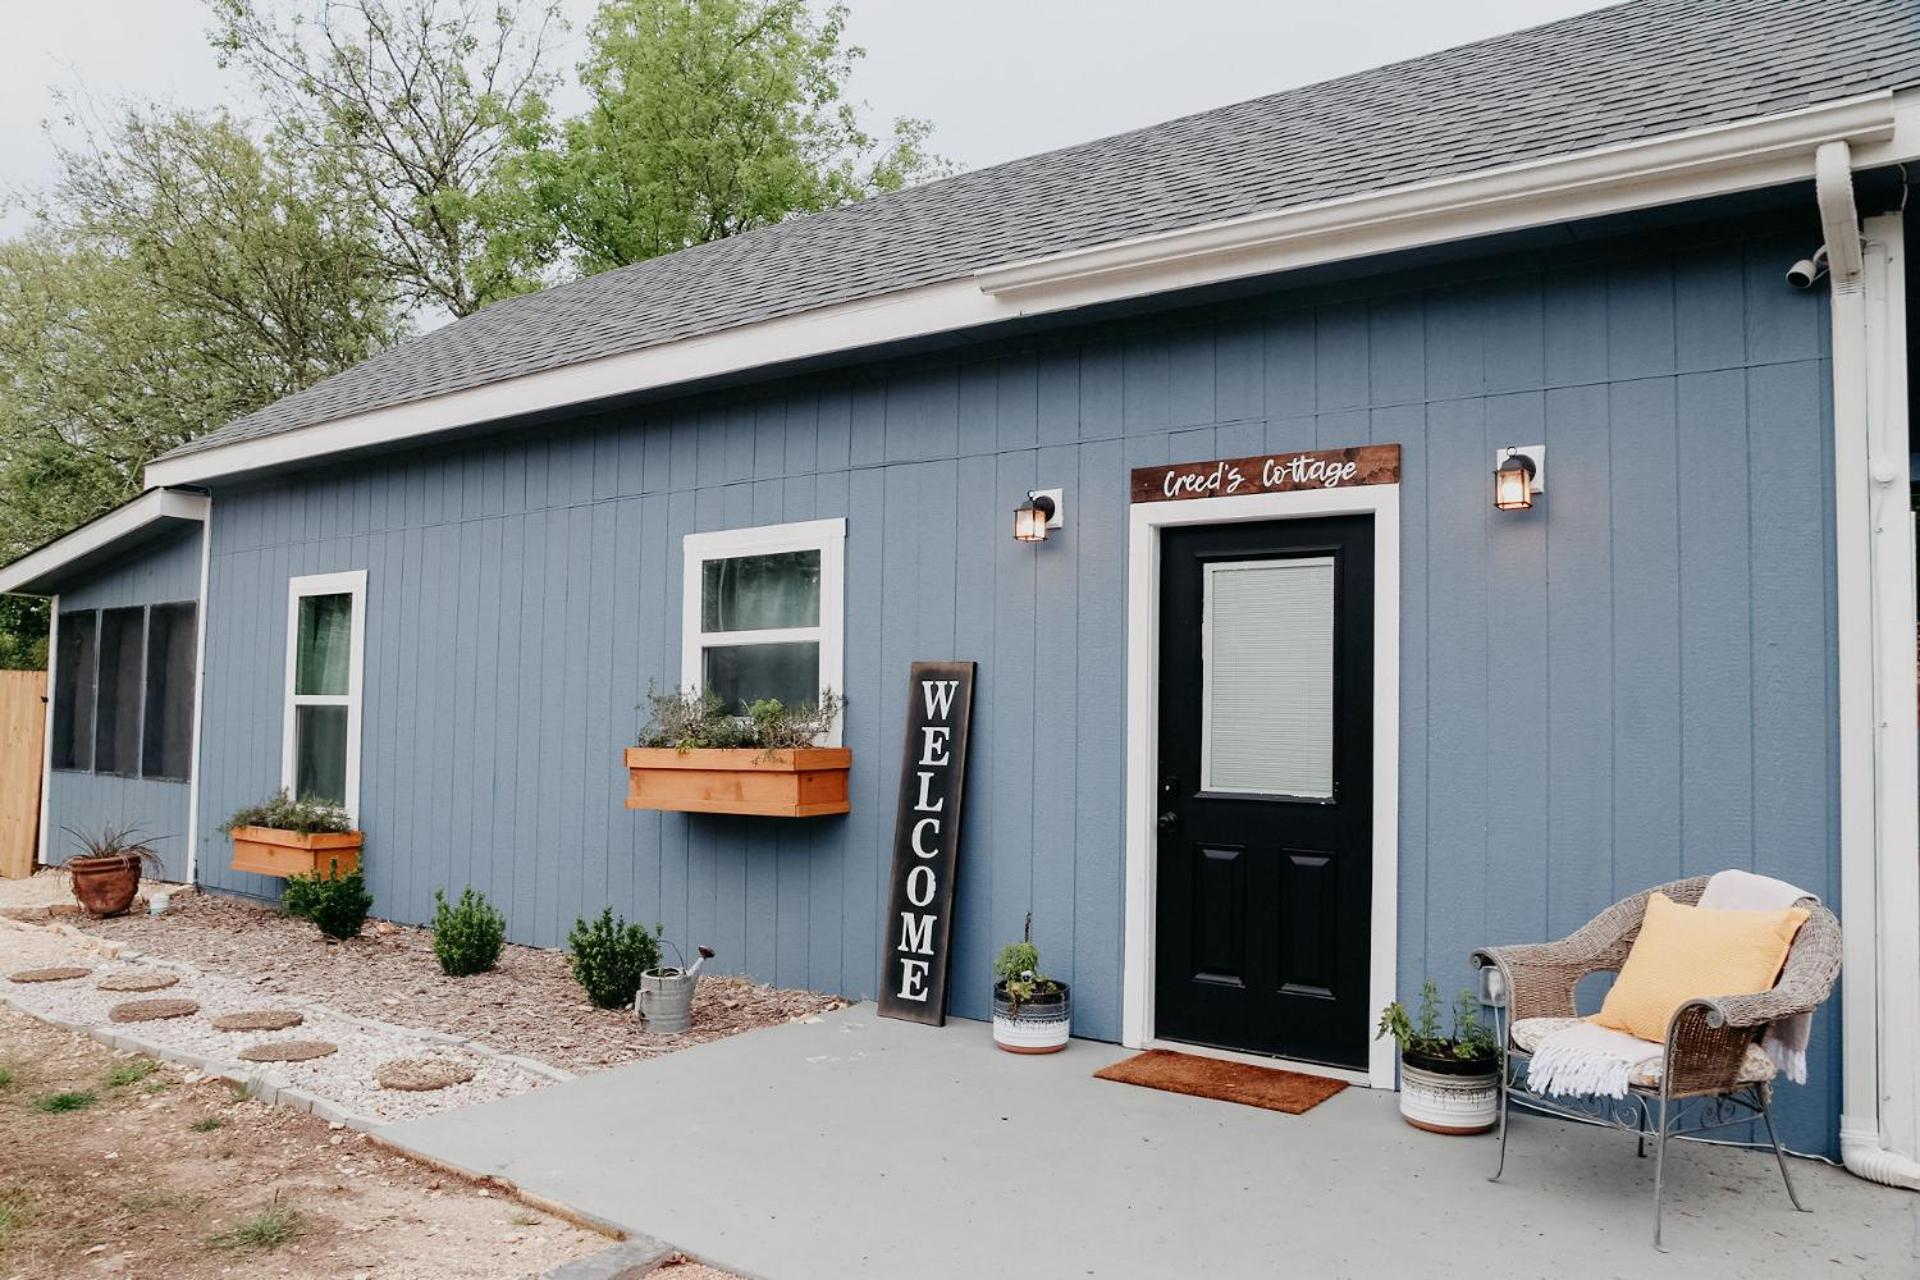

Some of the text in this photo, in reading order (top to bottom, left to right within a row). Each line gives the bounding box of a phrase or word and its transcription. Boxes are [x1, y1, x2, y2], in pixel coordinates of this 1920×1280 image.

[1163, 455, 1357, 497] Creed's Cottage
[897, 680, 959, 1002] WELCOME
